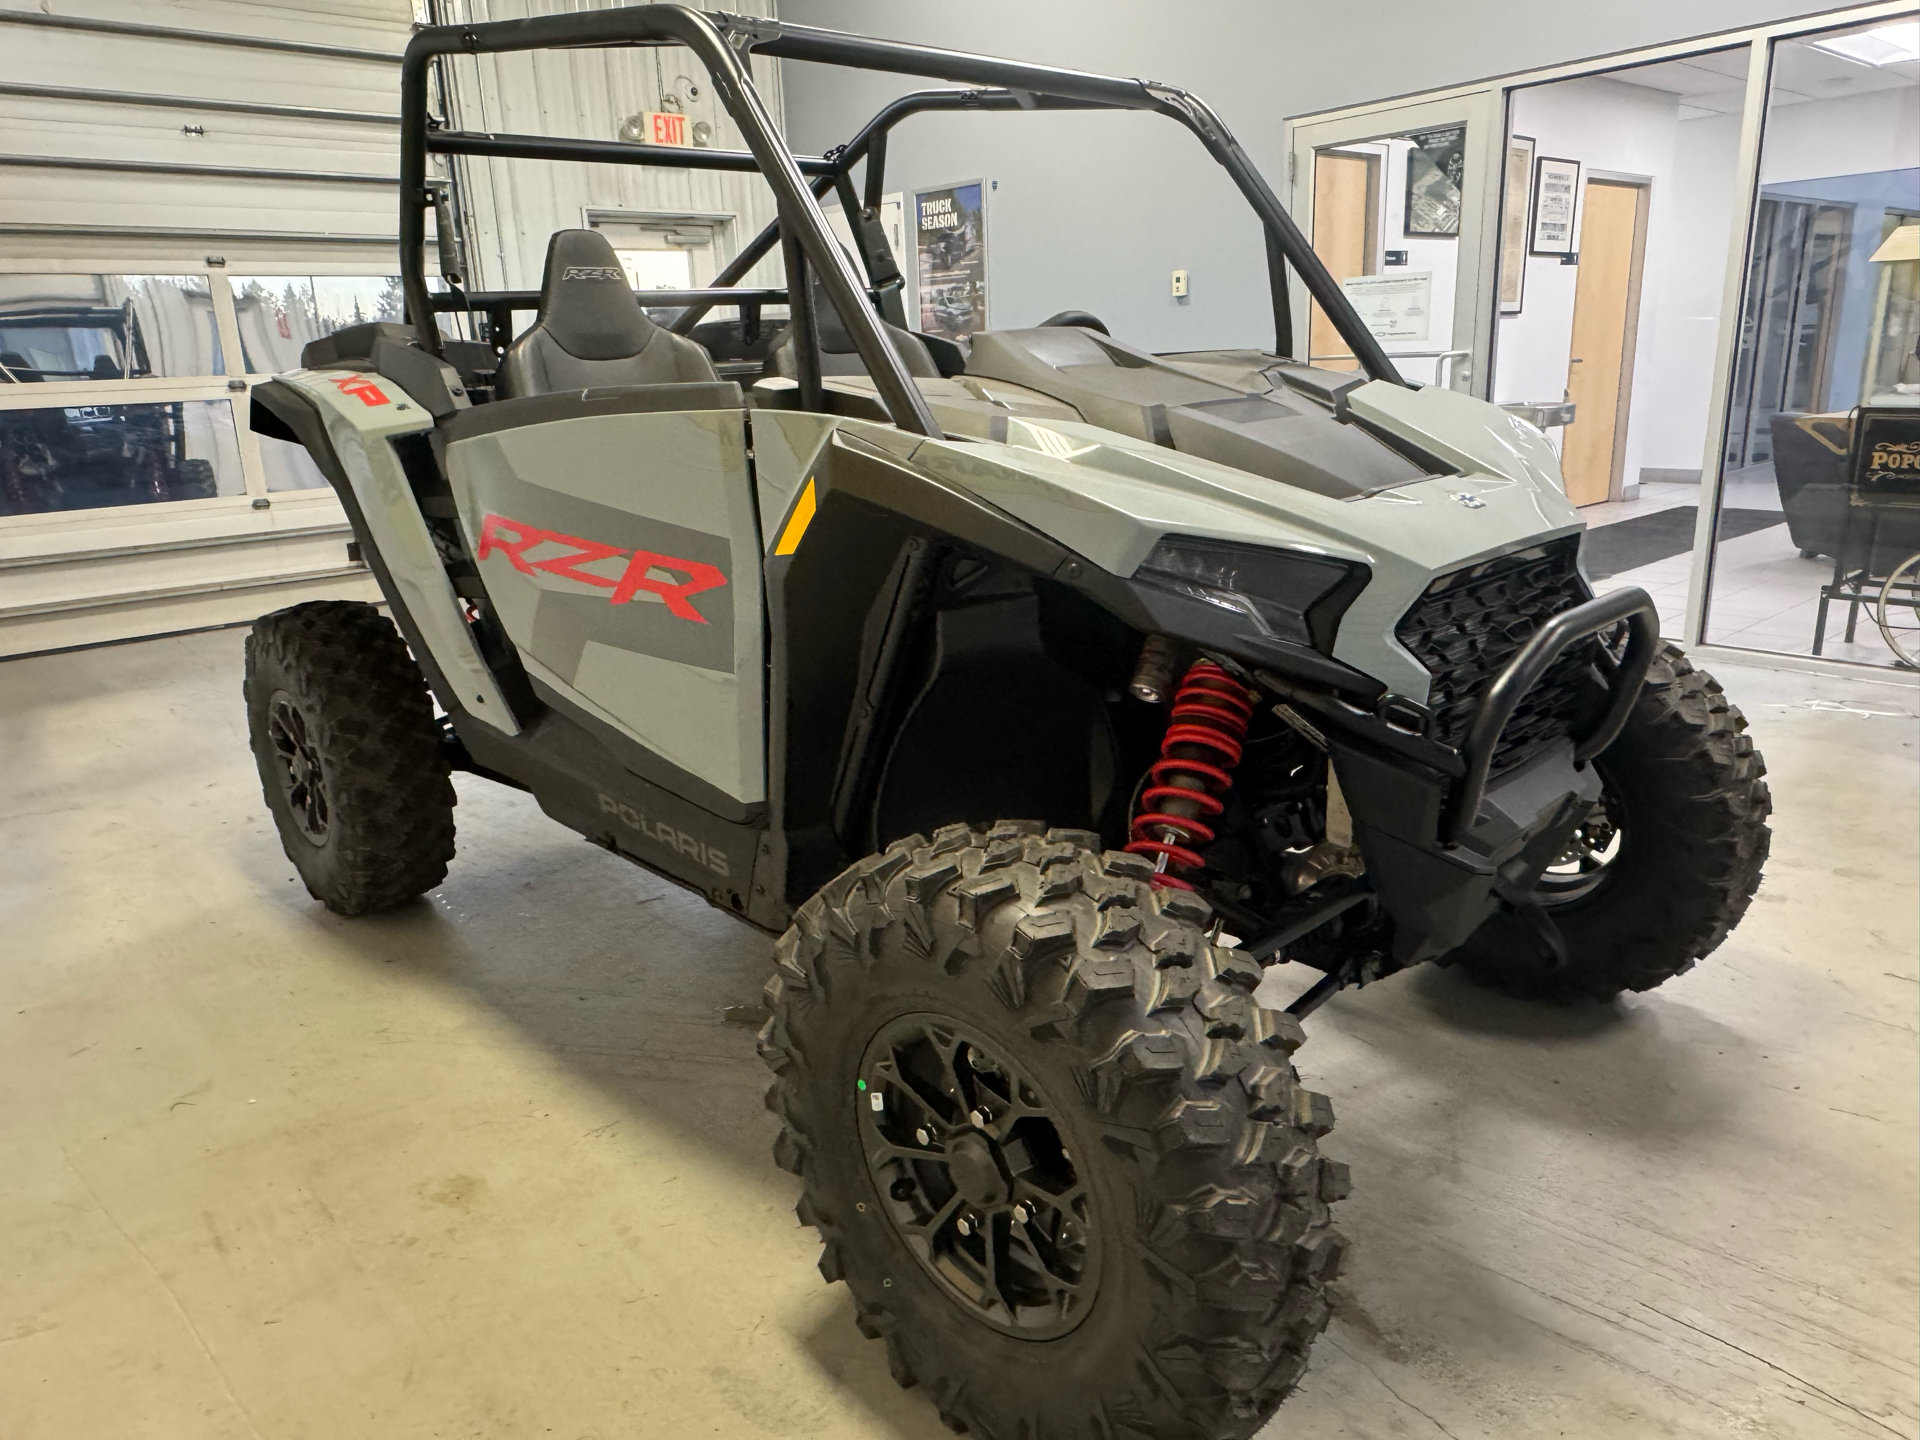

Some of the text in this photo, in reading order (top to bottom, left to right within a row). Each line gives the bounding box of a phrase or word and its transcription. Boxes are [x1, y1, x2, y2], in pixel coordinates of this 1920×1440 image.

[653, 115, 685, 145] EXIT
[921, 198, 952, 216] TRUCK
[922, 212, 958, 230] SEASON
[562, 266, 621, 280] RZR
[328, 374, 391, 407] XP
[478, 513, 728, 625] RZR
[598, 792, 730, 876] POLARIS
